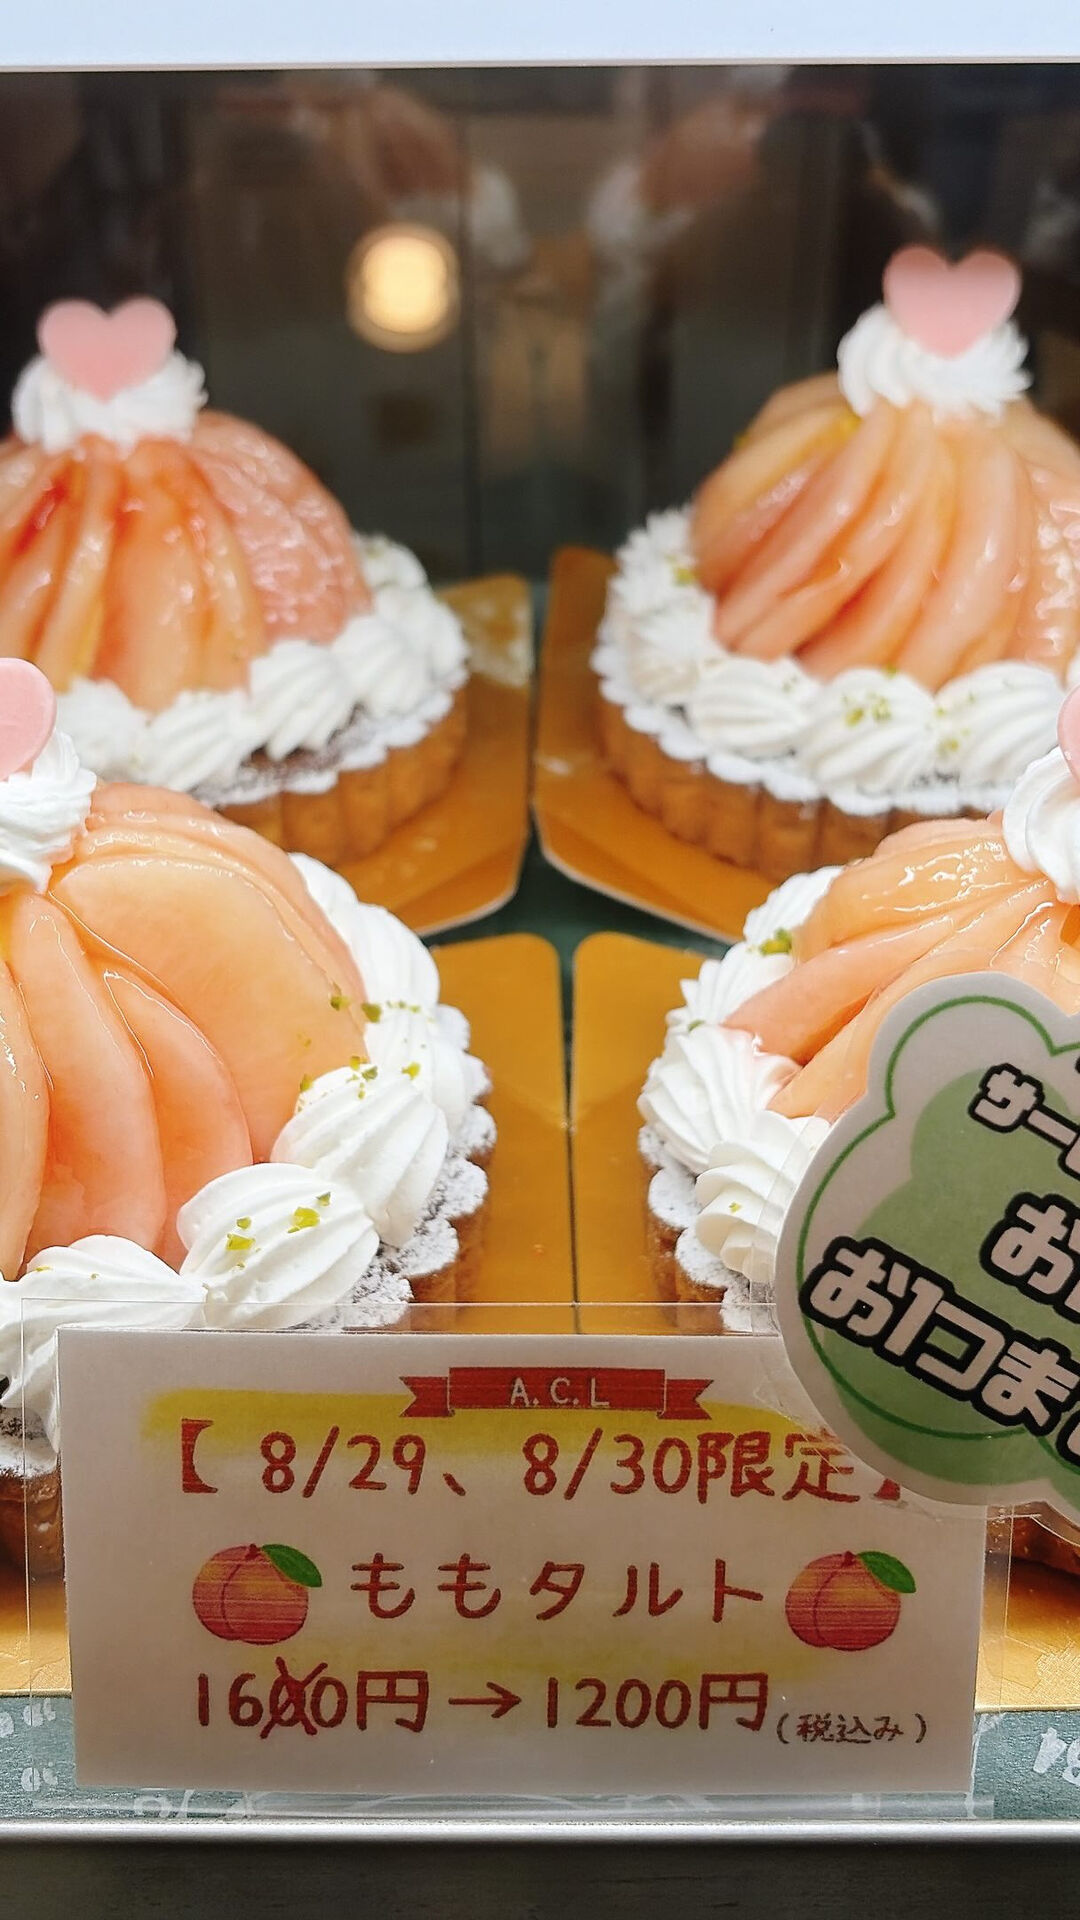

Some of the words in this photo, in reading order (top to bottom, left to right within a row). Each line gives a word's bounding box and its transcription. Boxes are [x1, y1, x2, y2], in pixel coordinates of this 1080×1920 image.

[970, 1063, 1080, 1181] サー
[800, 1235, 1080, 1468] お1つま
[350, 1552, 765, 1624] ももタルト
[546, 1672, 769, 1732] 1200円
